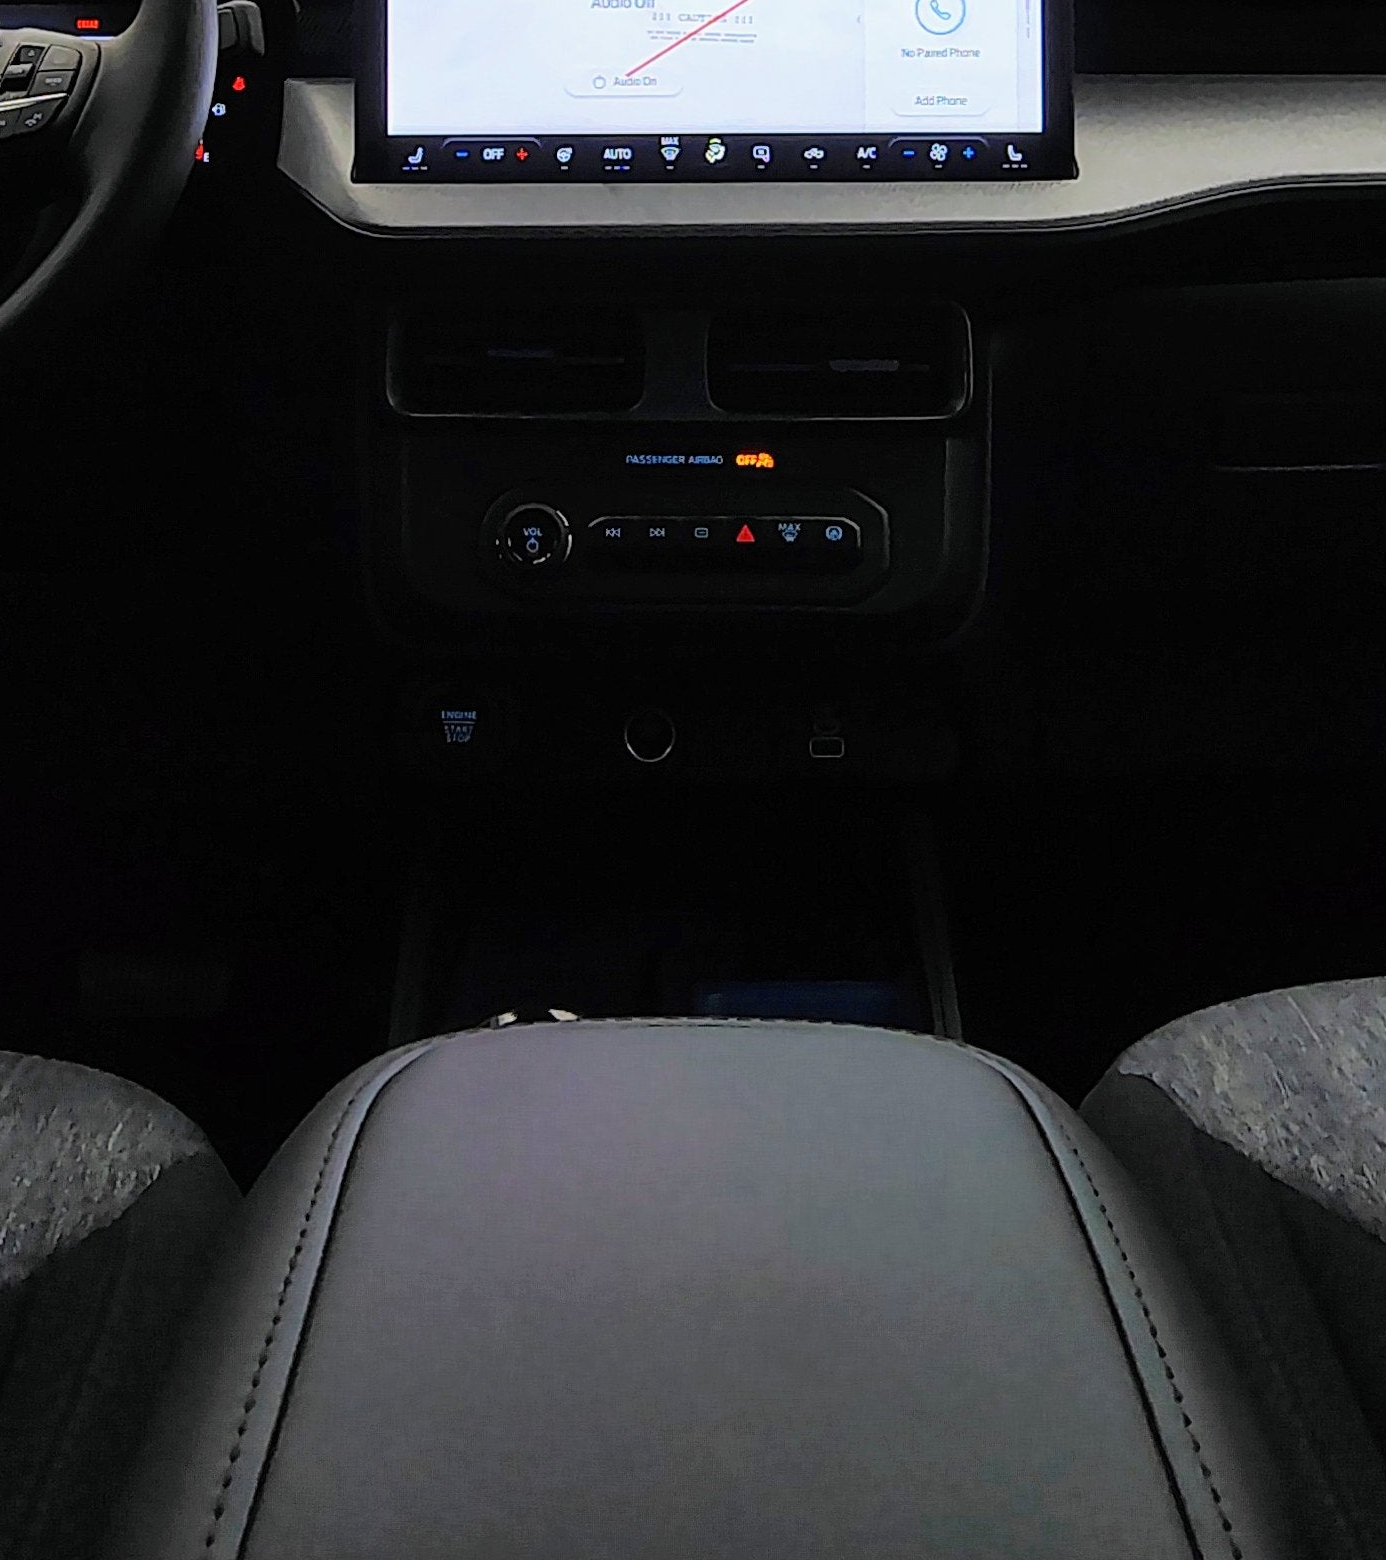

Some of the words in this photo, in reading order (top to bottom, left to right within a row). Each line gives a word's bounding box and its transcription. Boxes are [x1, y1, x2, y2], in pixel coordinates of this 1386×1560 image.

[900, 48, 915, 58] No
[949, 47, 981, 58] Phone
[612, 76, 641, 87] Audio
[643, 76, 658, 87] On
[914, 95, 935, 106] Add
[936, 95, 968, 106] Phone
[482, 148, 505, 160] OFF
[603, 148, 632, 160] AUTO
[856, 146, 877, 159] A/C
[625, 454, 686, 465] PASSENGER
[522, 527, 543, 537] VOL
